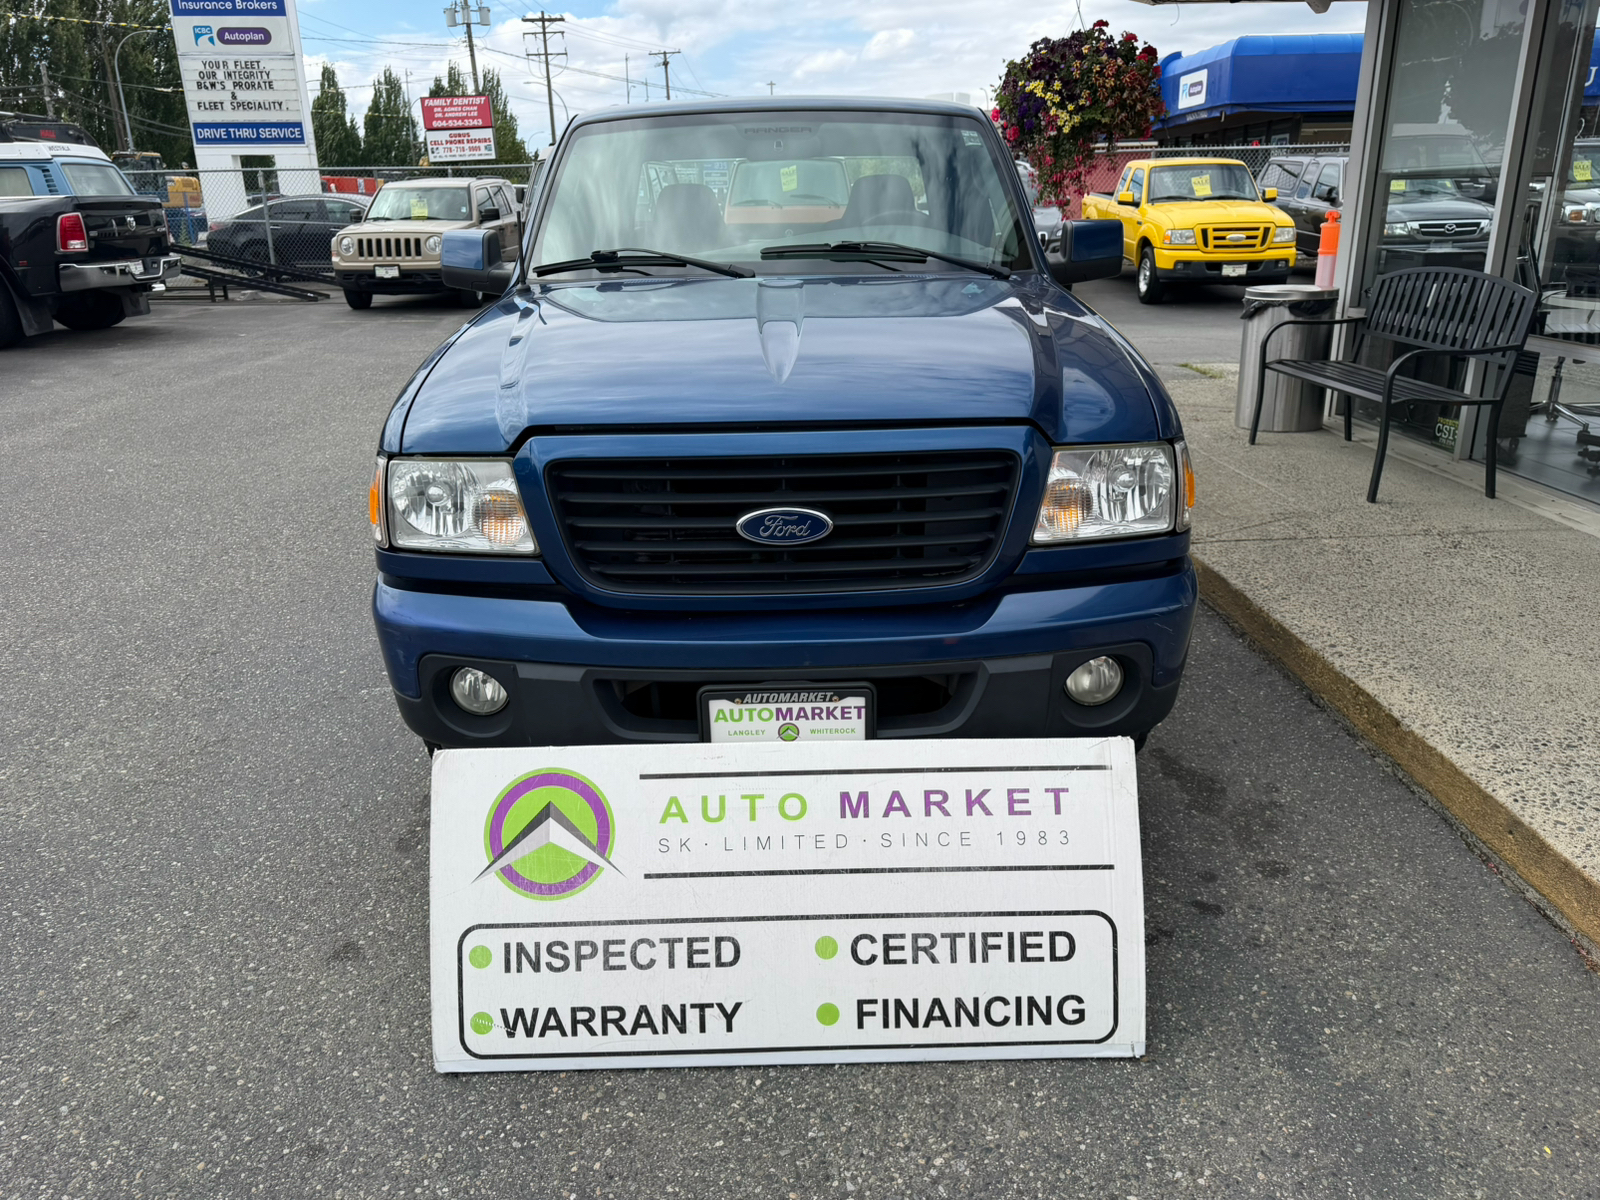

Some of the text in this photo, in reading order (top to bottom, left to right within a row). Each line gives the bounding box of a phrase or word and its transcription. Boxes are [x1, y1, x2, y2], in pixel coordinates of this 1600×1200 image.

[178, 0, 278, 10] Insurance Brokers
[224, 32, 265, 42] Autoplan
[201, 60, 266, 70] YOUR FLEET.
[198, 70, 271, 80] OUR INTEGRITY
[196, 81, 275, 90] B&W'S PRORATE
[231, 91, 238, 100] &
[197, 101, 289, 111] FLEET SPECIALITY.
[424, 97, 486, 107] FAMILY DENTIST
[197, 127, 302, 139] DRIVE THRU SERVICE
[744, 126, 812, 134] RANGER
[759, 514, 812, 537] Ford
[743, 692, 834, 704] AUTOMARKET
[713, 705, 866, 723] AUTOMARKET
[809, 727, 856, 735] WHITEROCK
[658, 787, 1070, 825] AUTO MARKET
[658, 829, 1071, 853] SK LIMITED SINCE 1983
[850, 930, 1077, 966] CERTIFIED
[503, 935, 741, 974] INSPECTED
[856, 994, 1086, 1030] FINANCING
[499, 1001, 744, 1039] WARRANTY
